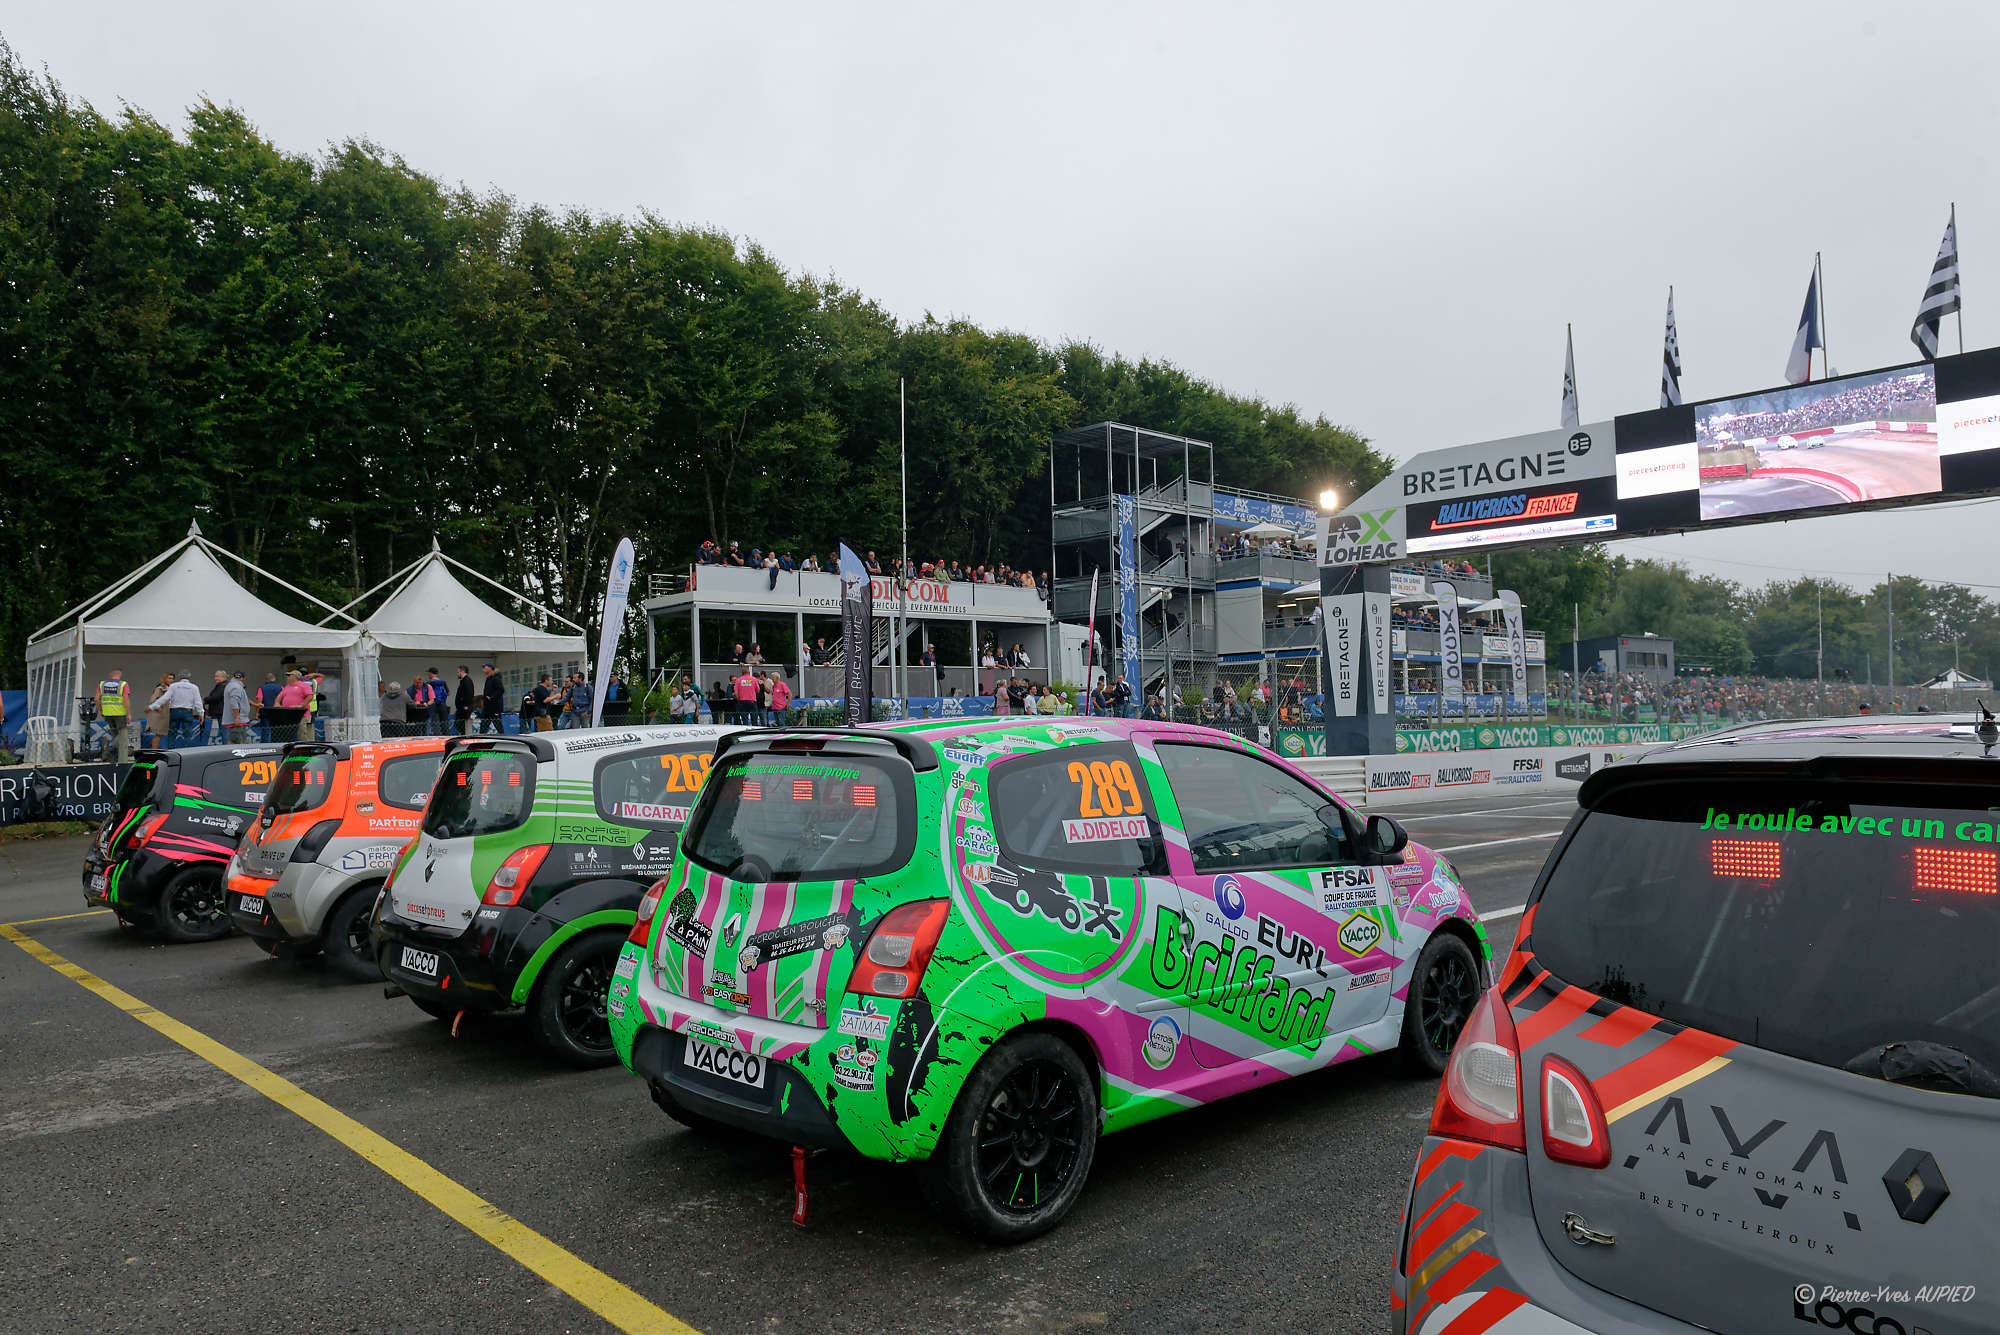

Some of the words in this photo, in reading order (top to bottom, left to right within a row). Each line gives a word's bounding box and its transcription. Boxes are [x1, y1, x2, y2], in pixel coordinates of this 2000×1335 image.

[1403, 450, 1565, 497] BRETAGNE
[1437, 494, 1527, 525] RALLYCROSS
[1528, 495, 1575, 515] FRANCE
[1327, 509, 1397, 549] RX
[1324, 542, 1398, 565] LOHEAC
[1338, 617, 1351, 699] BRETAGNE
[1375, 615, 1384, 697] BRETAGNE
[1410, 730, 1460, 753] YACCO
[1496, 727, 1538, 747] YACCO
[1568, 728, 1604, 746] YACCO
[1630, 726, 1660, 743] YACCO
[239, 761, 278, 785] 291
[767, 764, 779, 774] un
[779, 761, 825, 776] carburant
[823, 766, 861, 781] propre
[1437, 767, 1473, 784] RALLYCROSS
[1513, 758, 1541, 771] FFSA
[1067, 760, 1143, 818] 289
[1371, 770, 1411, 789] RALLYCROSS
[1508, 774, 1542, 784] RALLYCROSS
[1069, 819, 1146, 841] A.DIDELOT
[1700, 808, 1727, 831] Je
[1737, 808, 1812, 833] roule
[1820, 815, 1893, 837] avec
[1901, 818, 1945, 840] un
[559, 834, 627, 844] RACING
[956, 837, 999, 854] GARAGE
[970, 833, 988, 843] TOP
[1321, 868, 1370, 889] FFSA
[1324, 893, 1345, 903] COUPE
[1345, 892, 1354, 901] DE
[1354, 889, 1377, 900] FRANCE
[783, 926, 796, 937] EN
[799, 915, 843, 933] BOUCHE
[1206, 912, 1249, 942] GALLOO
[1344, 927, 1378, 943] YACCO
[686, 929, 709, 950] PAIN
[771, 938, 797, 950] TRAITEUR
[1258, 916, 1328, 979] EURL
[404, 949, 436, 974] YACCO
[1151, 904, 1336, 1051] Briffard
[1350, 973, 1377, 989] RALLYCROSS
[687, 1021, 707, 1036] MERCI
[707, 1026, 737, 1043] CHRISTO
[840, 1014, 889, 1035] SATIMAT
[691, 1040, 759, 1084] YACCO
[1646, 1143, 1688, 1161] AXA
[1705, 1157, 1842, 1200] CÉNOMANS
[1639, 1191, 1835, 1255] BRETOT-LEROUX
